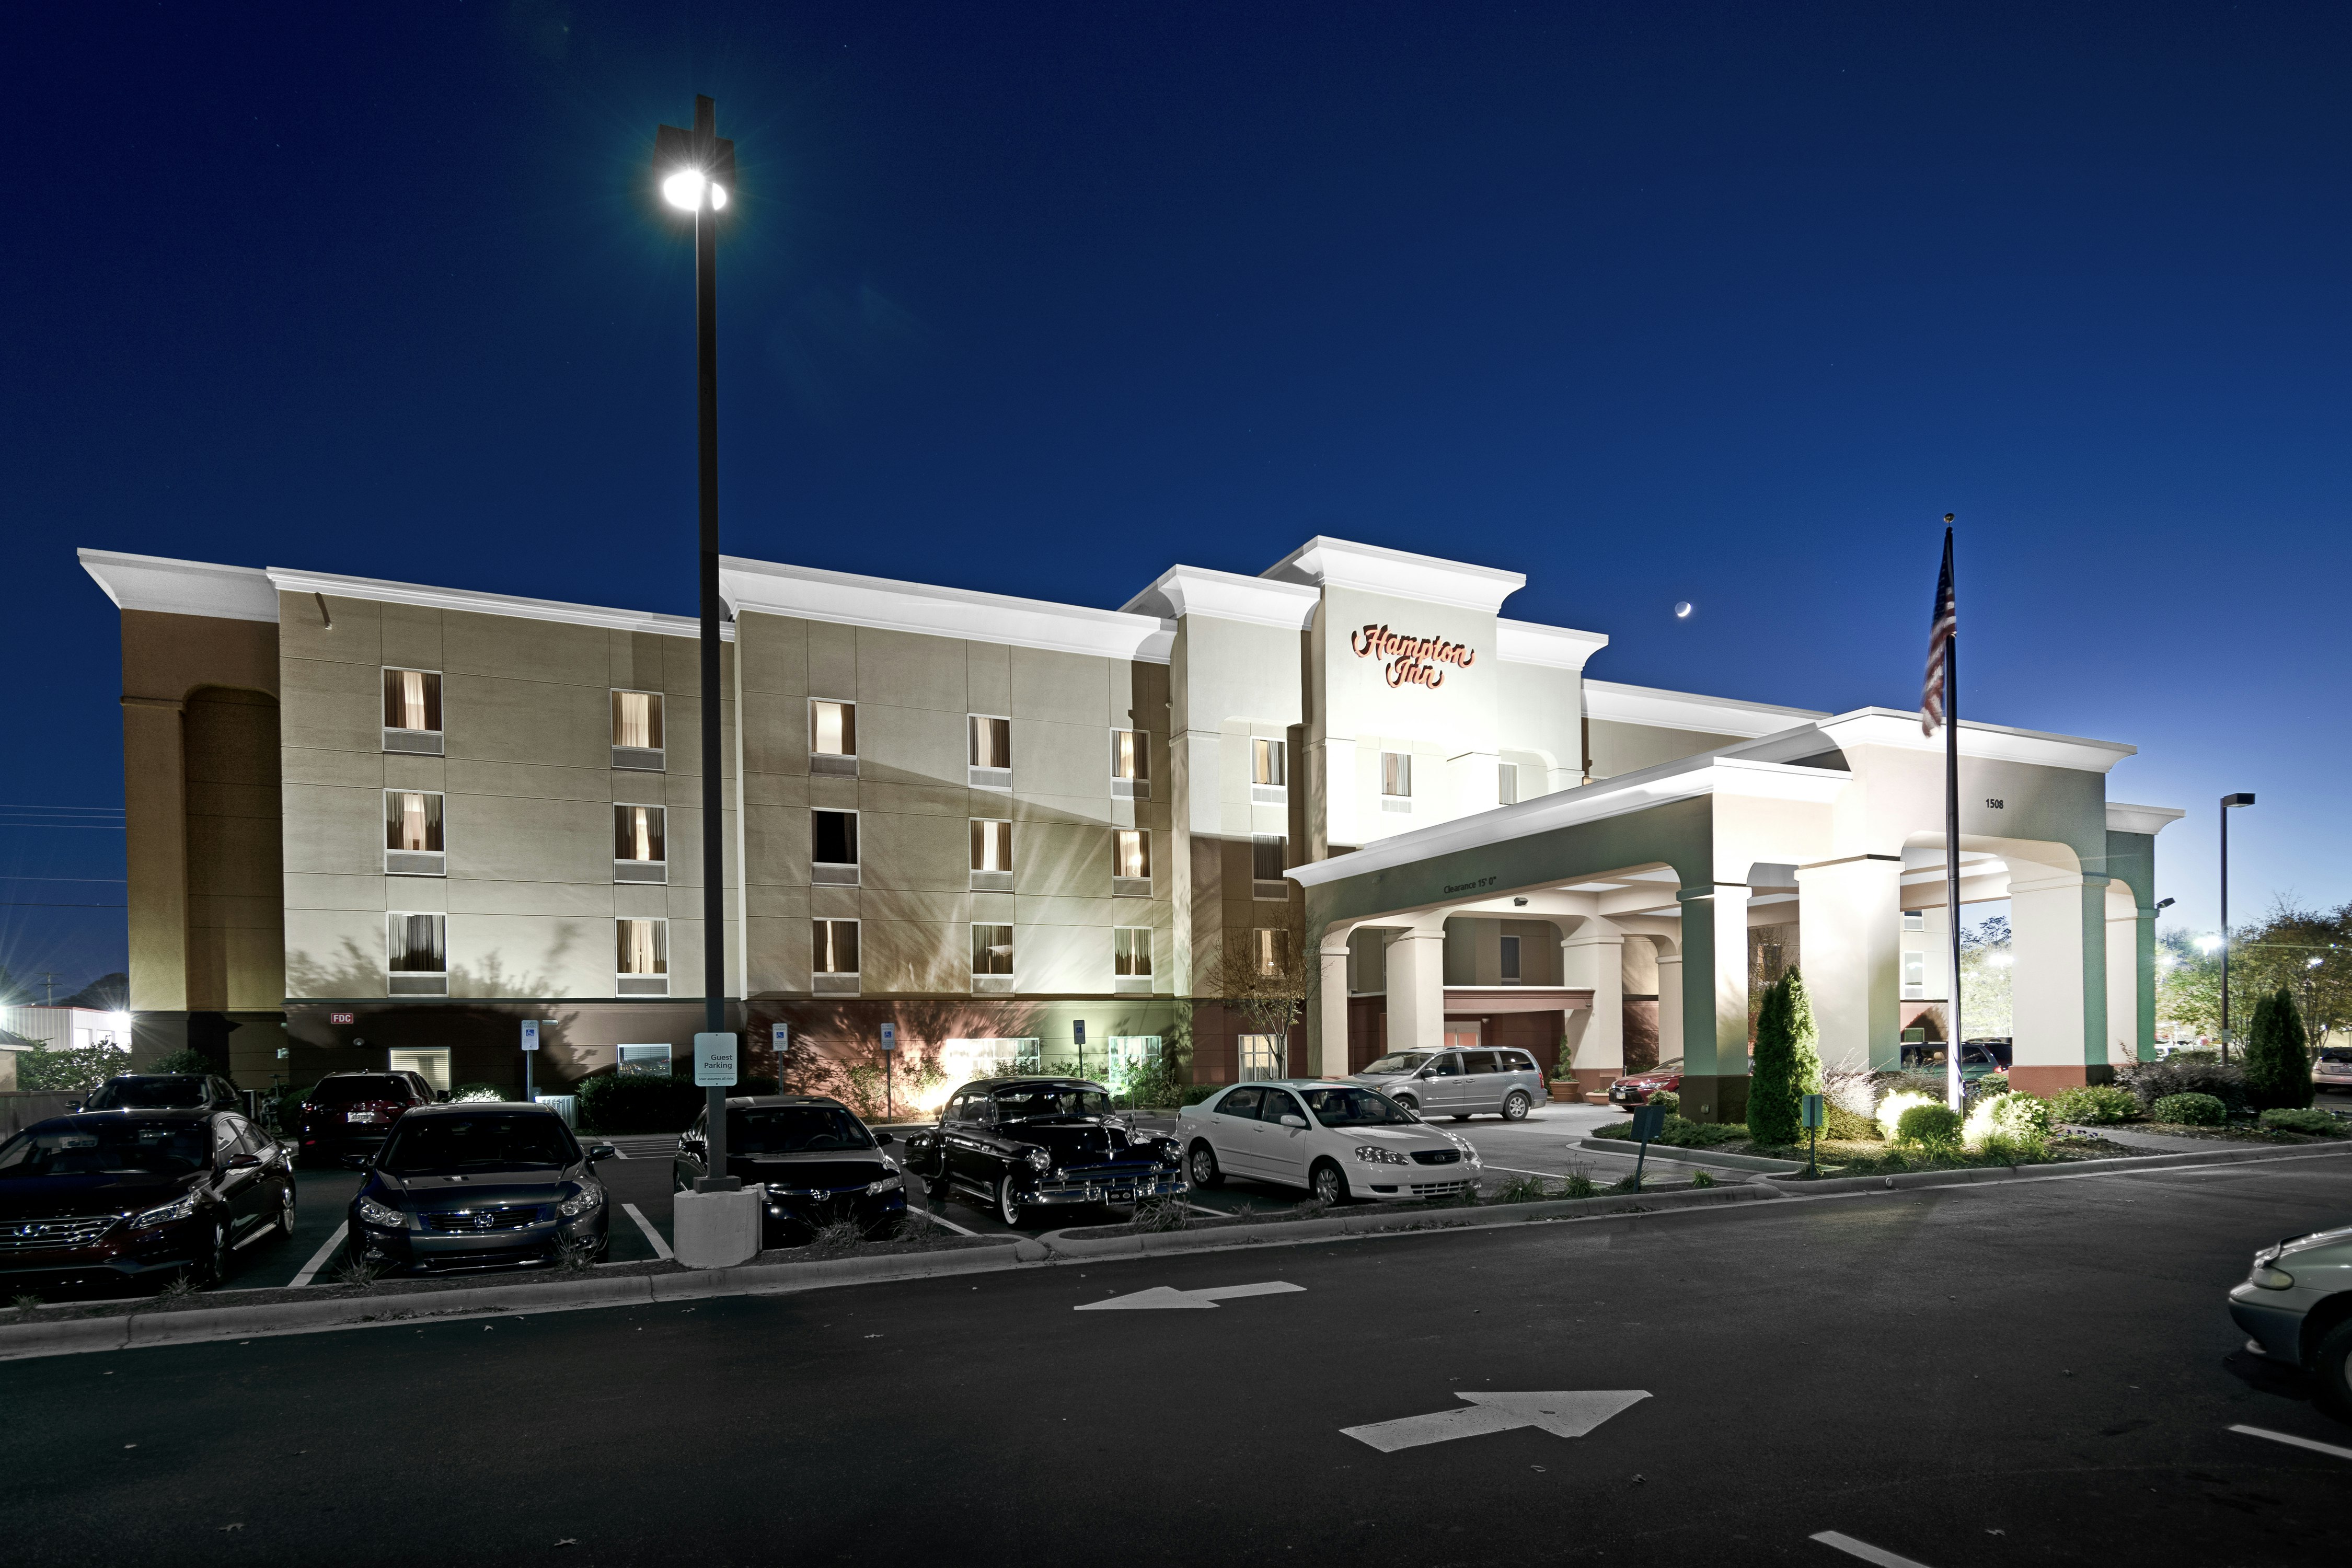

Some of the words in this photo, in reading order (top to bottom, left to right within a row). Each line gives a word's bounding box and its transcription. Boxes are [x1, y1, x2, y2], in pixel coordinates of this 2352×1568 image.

[1351, 624, 1477, 668] Hampton
[1386, 656, 1445, 689] Inn
[1986, 798, 2004, 810] 1508
[1444, 882, 1476, 894] Clearance
